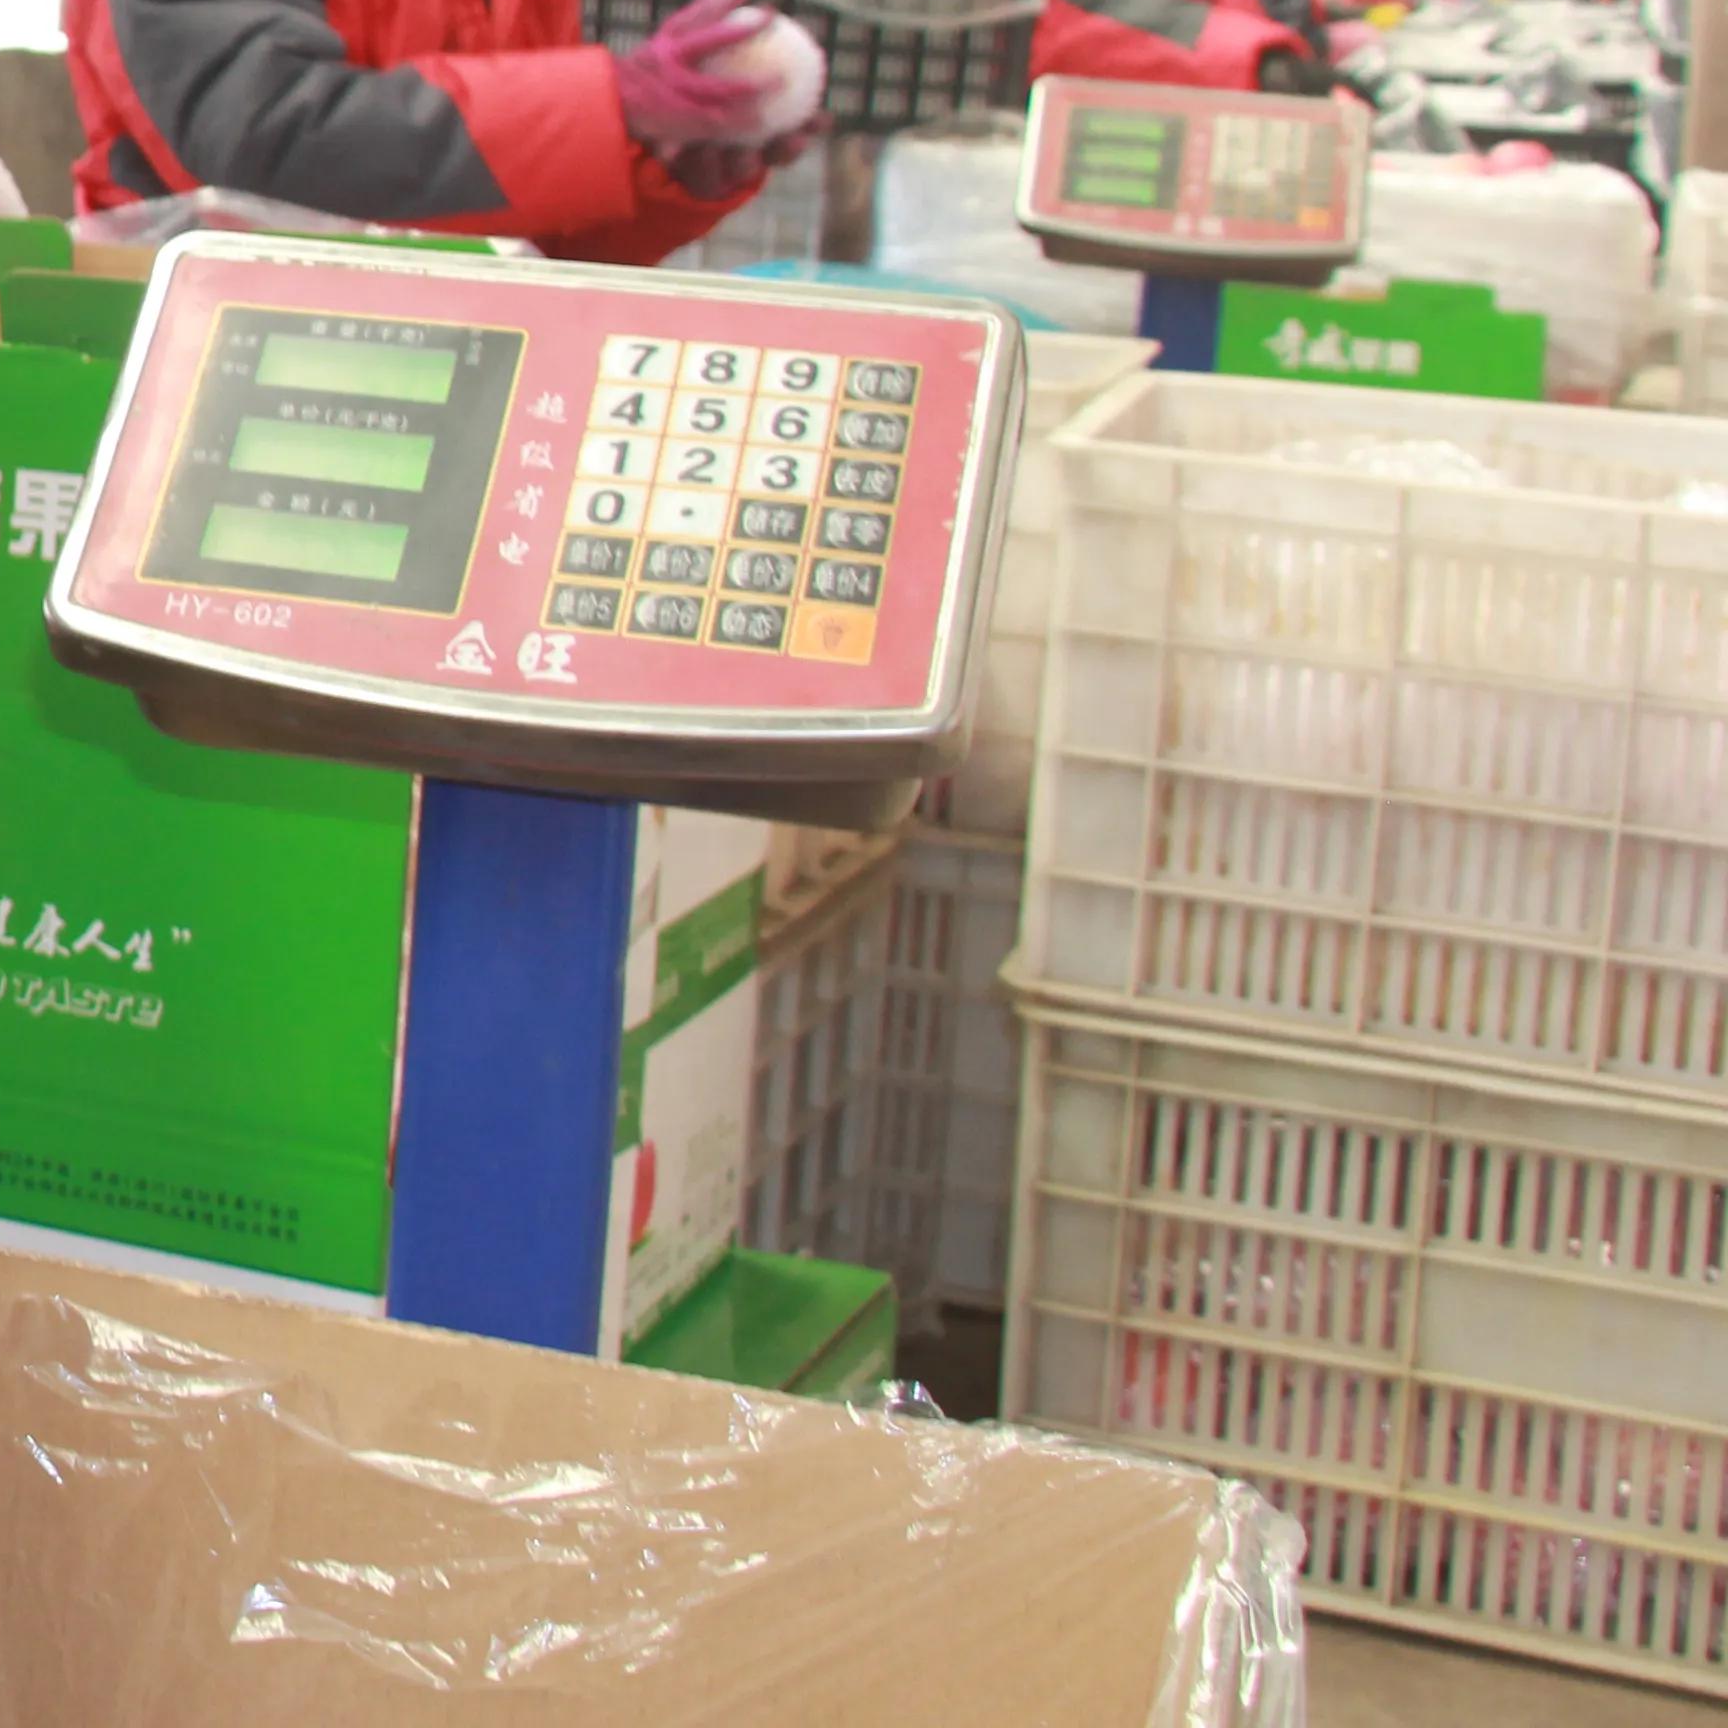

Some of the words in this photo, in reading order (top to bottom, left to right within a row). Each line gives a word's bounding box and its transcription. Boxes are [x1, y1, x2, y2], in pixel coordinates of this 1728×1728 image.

[626, 344, 659, 376] 7
[700, 351, 737, 384] 8
[782, 358, 819, 391] 9
[610, 393, 644, 425] 4
[690, 399, 727, 433] 5
[771, 406, 810, 440] 6
[609, 440, 630, 475] 1
[677, 447, 717, 484] 2
[760, 455, 798, 490] 3
[586, 490, 625, 525] 0
[164, 592, 293, 629] HY-602
[435, 619, 579, 684] 金旺
